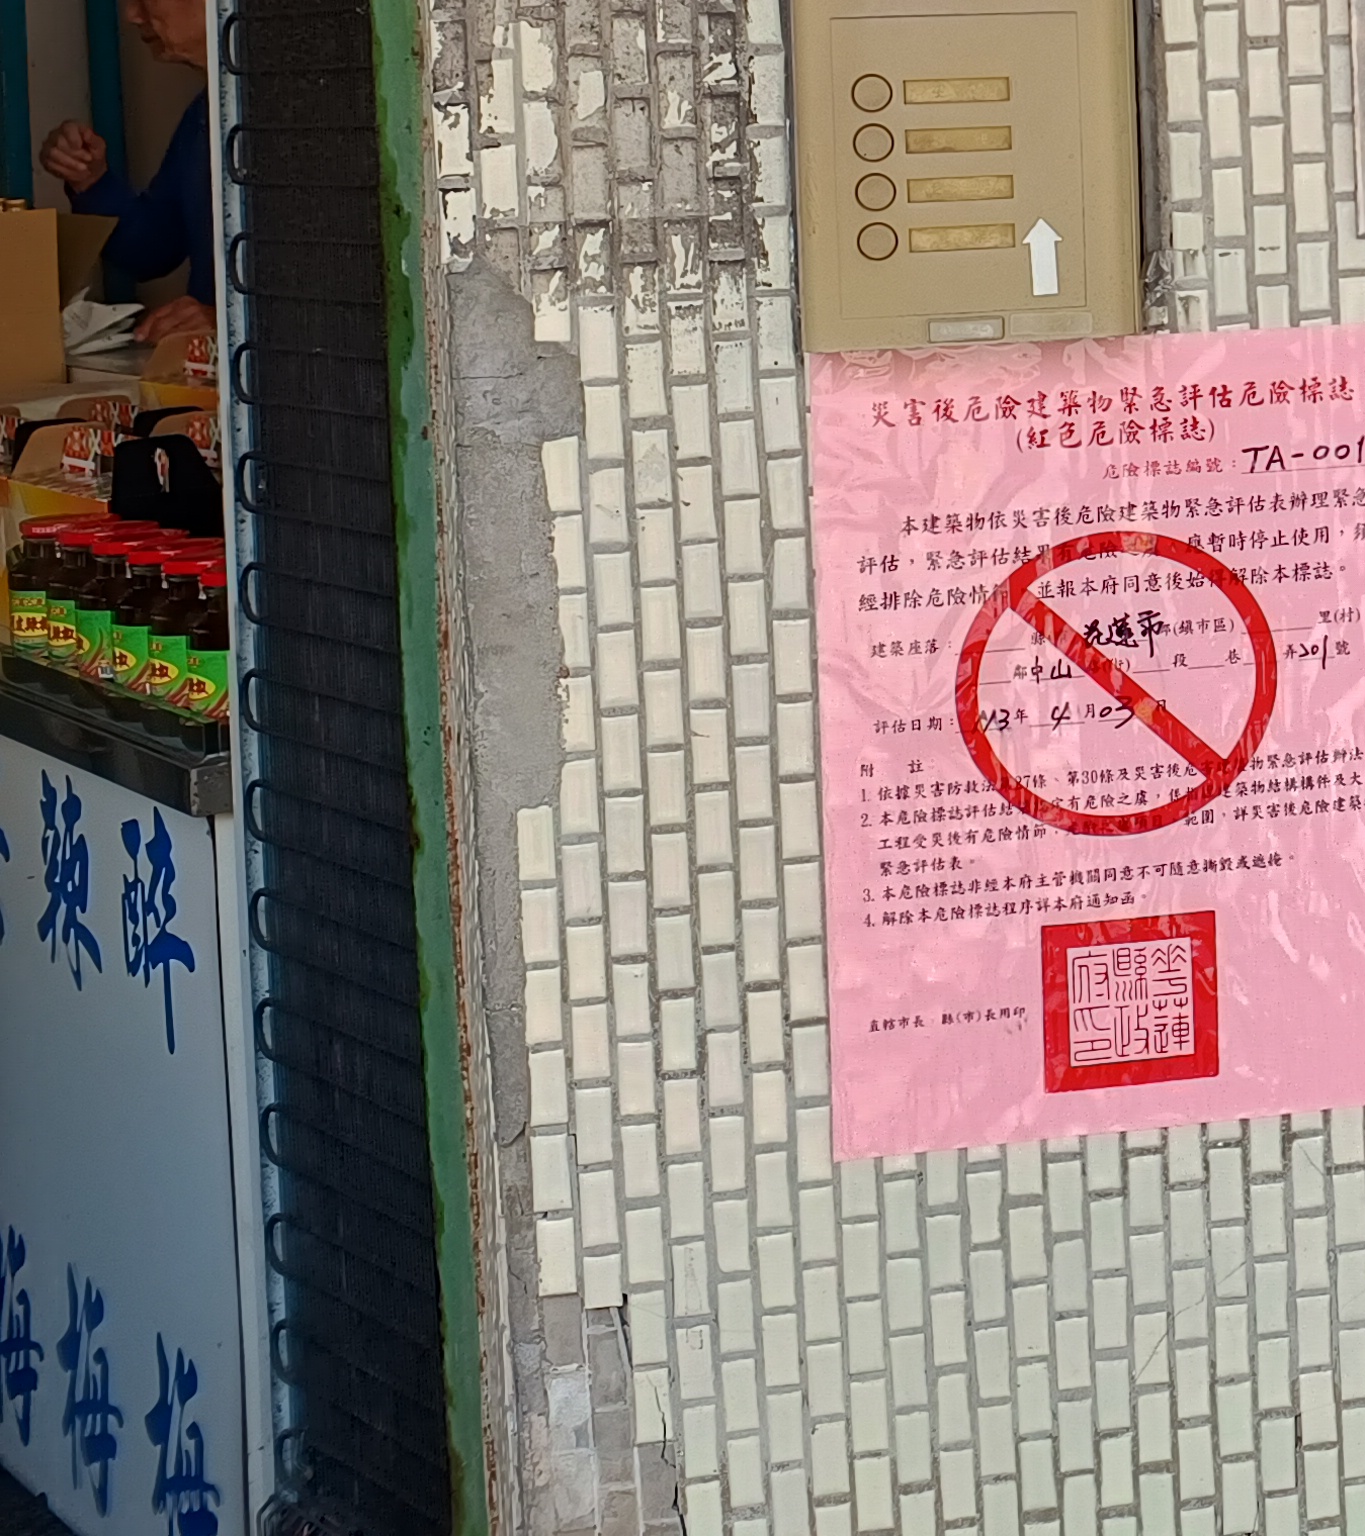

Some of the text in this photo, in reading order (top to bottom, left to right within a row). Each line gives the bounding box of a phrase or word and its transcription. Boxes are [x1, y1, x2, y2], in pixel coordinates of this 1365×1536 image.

[872, 375, 1355, 428] 災害後危險建築物緊急評估危險標誌
[1016, 415, 1215, 453] (紅色危險標誌)
[1241, 435, 1365, 474] TA-001
[1031, 657, 1073, 685] 中山
[1050, 702, 1072, 731] 4
